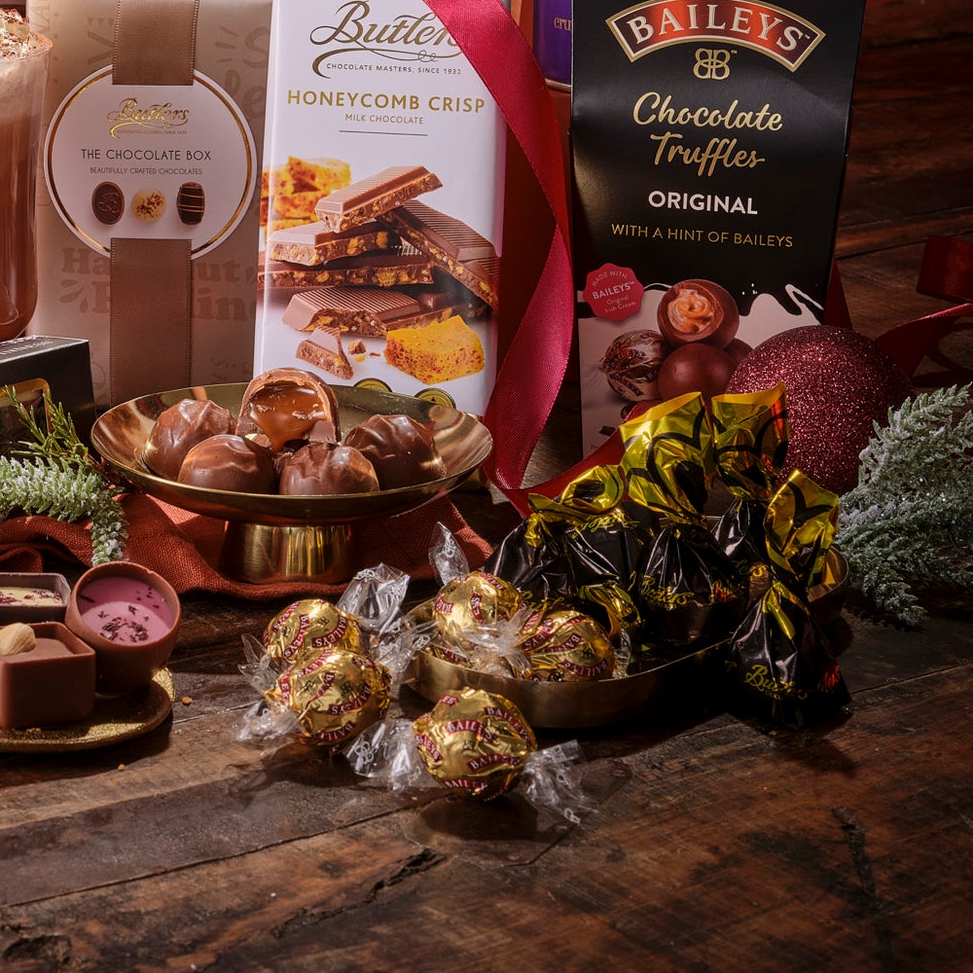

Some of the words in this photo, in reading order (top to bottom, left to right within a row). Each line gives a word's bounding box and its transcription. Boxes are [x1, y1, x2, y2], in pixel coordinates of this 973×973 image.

[327, 62, 372, 70] CHOCOLATE
[376, 65, 415, 73] MASTERS,
[107, 97, 190, 126] Butlers
[288, 89, 420, 110] HONEYCOMB
[428, 96, 485, 113] CRISP
[633, 91, 783, 131] Chocolate
[345, 113, 366, 122] MILK
[369, 114, 424, 124] CHOCOLATE
[81, 149, 101, 159] THE
[106, 149, 181, 160] CHOCOLATE
[186, 150, 212, 161] BOX
[650, 131, 766, 177] Truffles
[89, 167, 128, 175] BEAUTIFULLY
[130, 167, 157, 175] CRAFTED
[158, 167, 203, 175] CHOCOLATES
[648, 190, 758, 215] ORIGINAL
[611, 223, 648, 238] WITH
[652, 227, 663, 239] A
[667, 228, 703, 242] HINT
[707, 231, 729, 243] OF
[733, 232, 793, 248] BAILEYS
